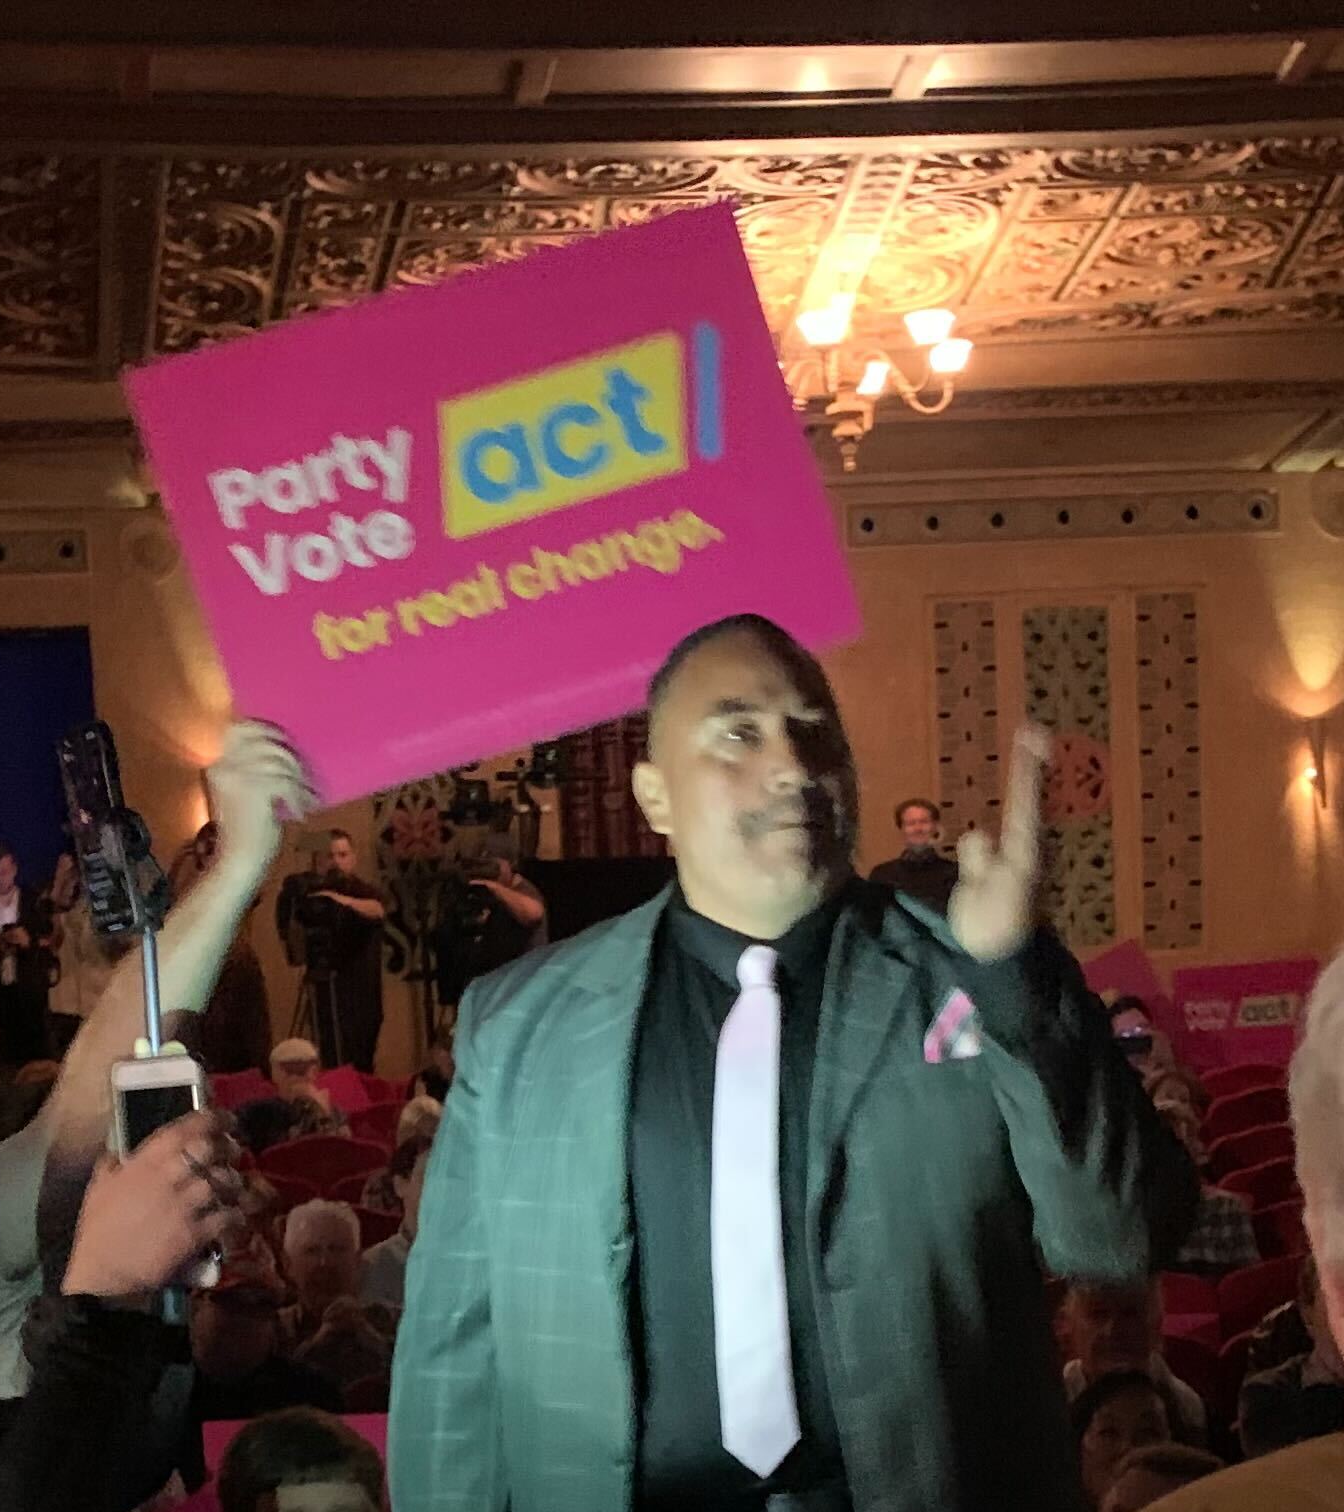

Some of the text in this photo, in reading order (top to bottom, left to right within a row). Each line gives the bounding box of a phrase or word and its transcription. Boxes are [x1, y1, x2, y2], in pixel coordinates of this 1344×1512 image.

[208, 427, 412, 529] Party
[231, 511, 415, 595] Vote
[313, 608, 390, 660] for
[397, 563, 506, 635] real
